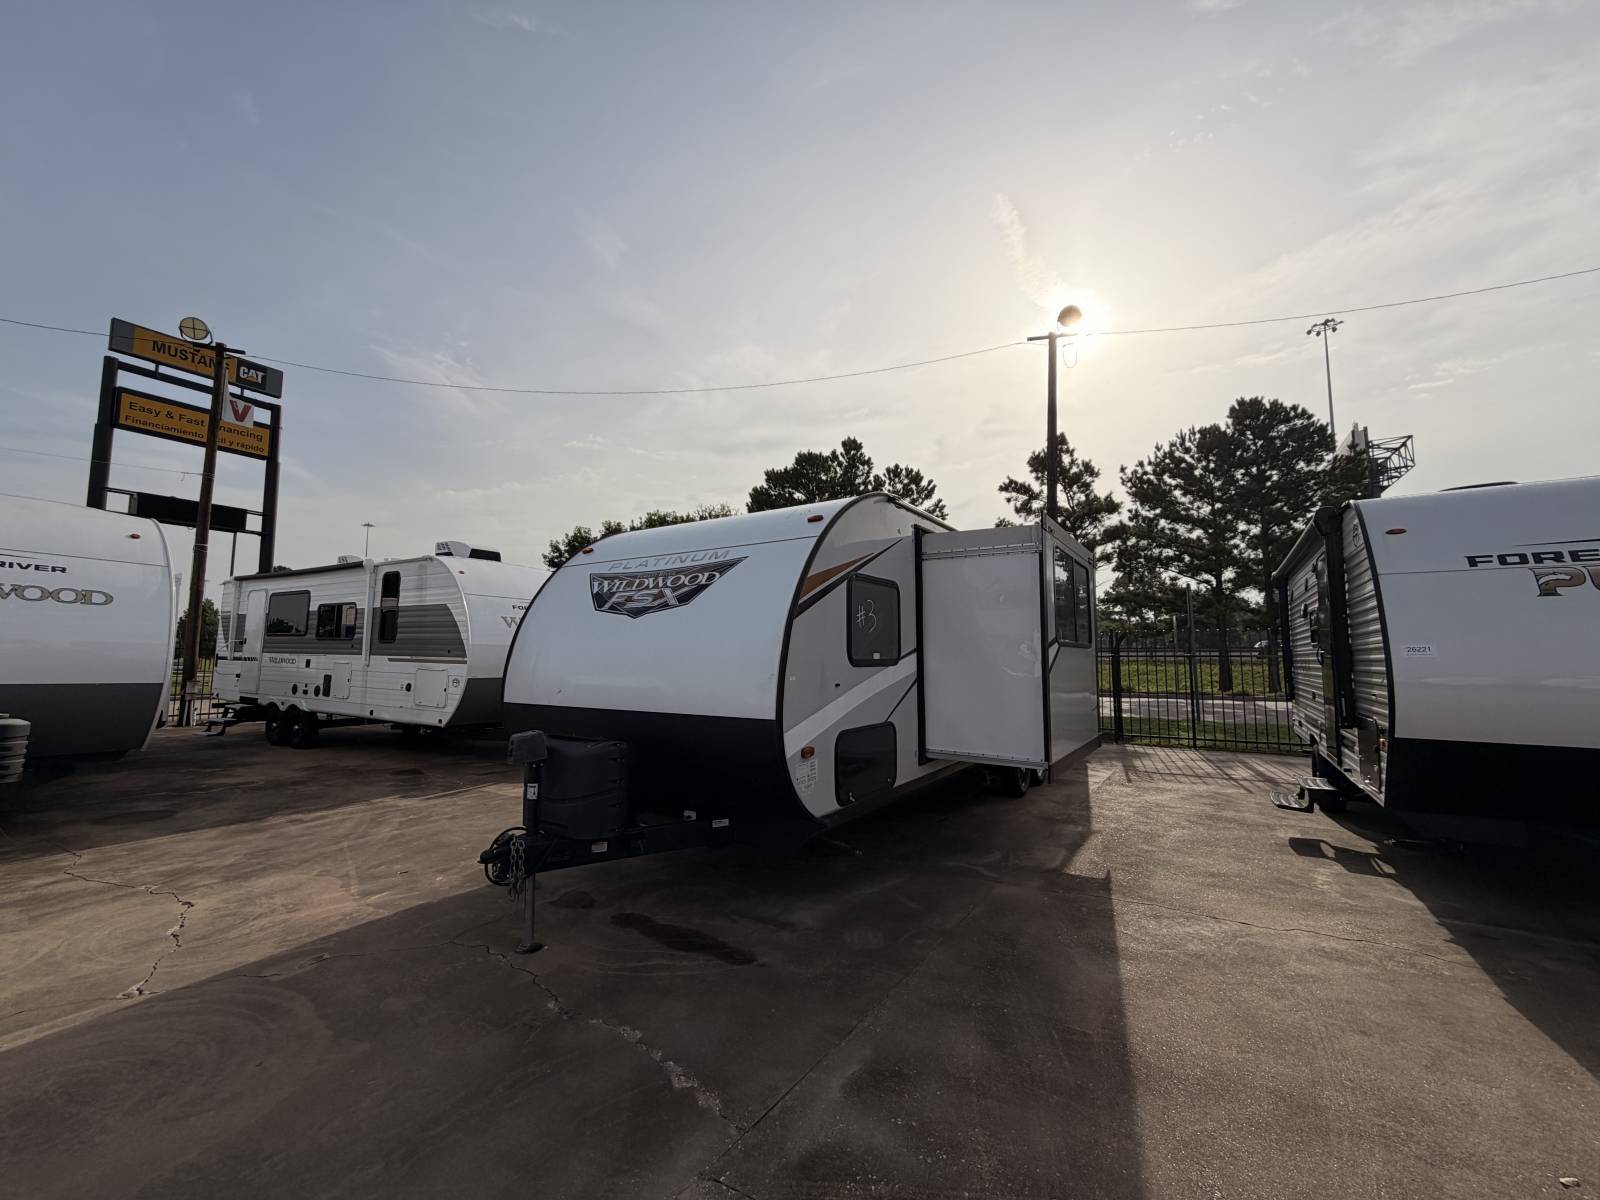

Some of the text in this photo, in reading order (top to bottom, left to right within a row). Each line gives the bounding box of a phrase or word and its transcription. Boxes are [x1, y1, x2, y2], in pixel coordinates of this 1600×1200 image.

[152, 341, 229, 369] MUSTAN
[240, 366, 264, 384] CAT
[124, 414, 205, 440] Financiamiento
[128, 400, 264, 443] Easy & Fast nancing
[608, 550, 731, 571] PLATINUM
[593, 571, 721, 594] WILDWOOD
[601, 588, 697, 610] FSX
[855, 599, 877, 633] #3
